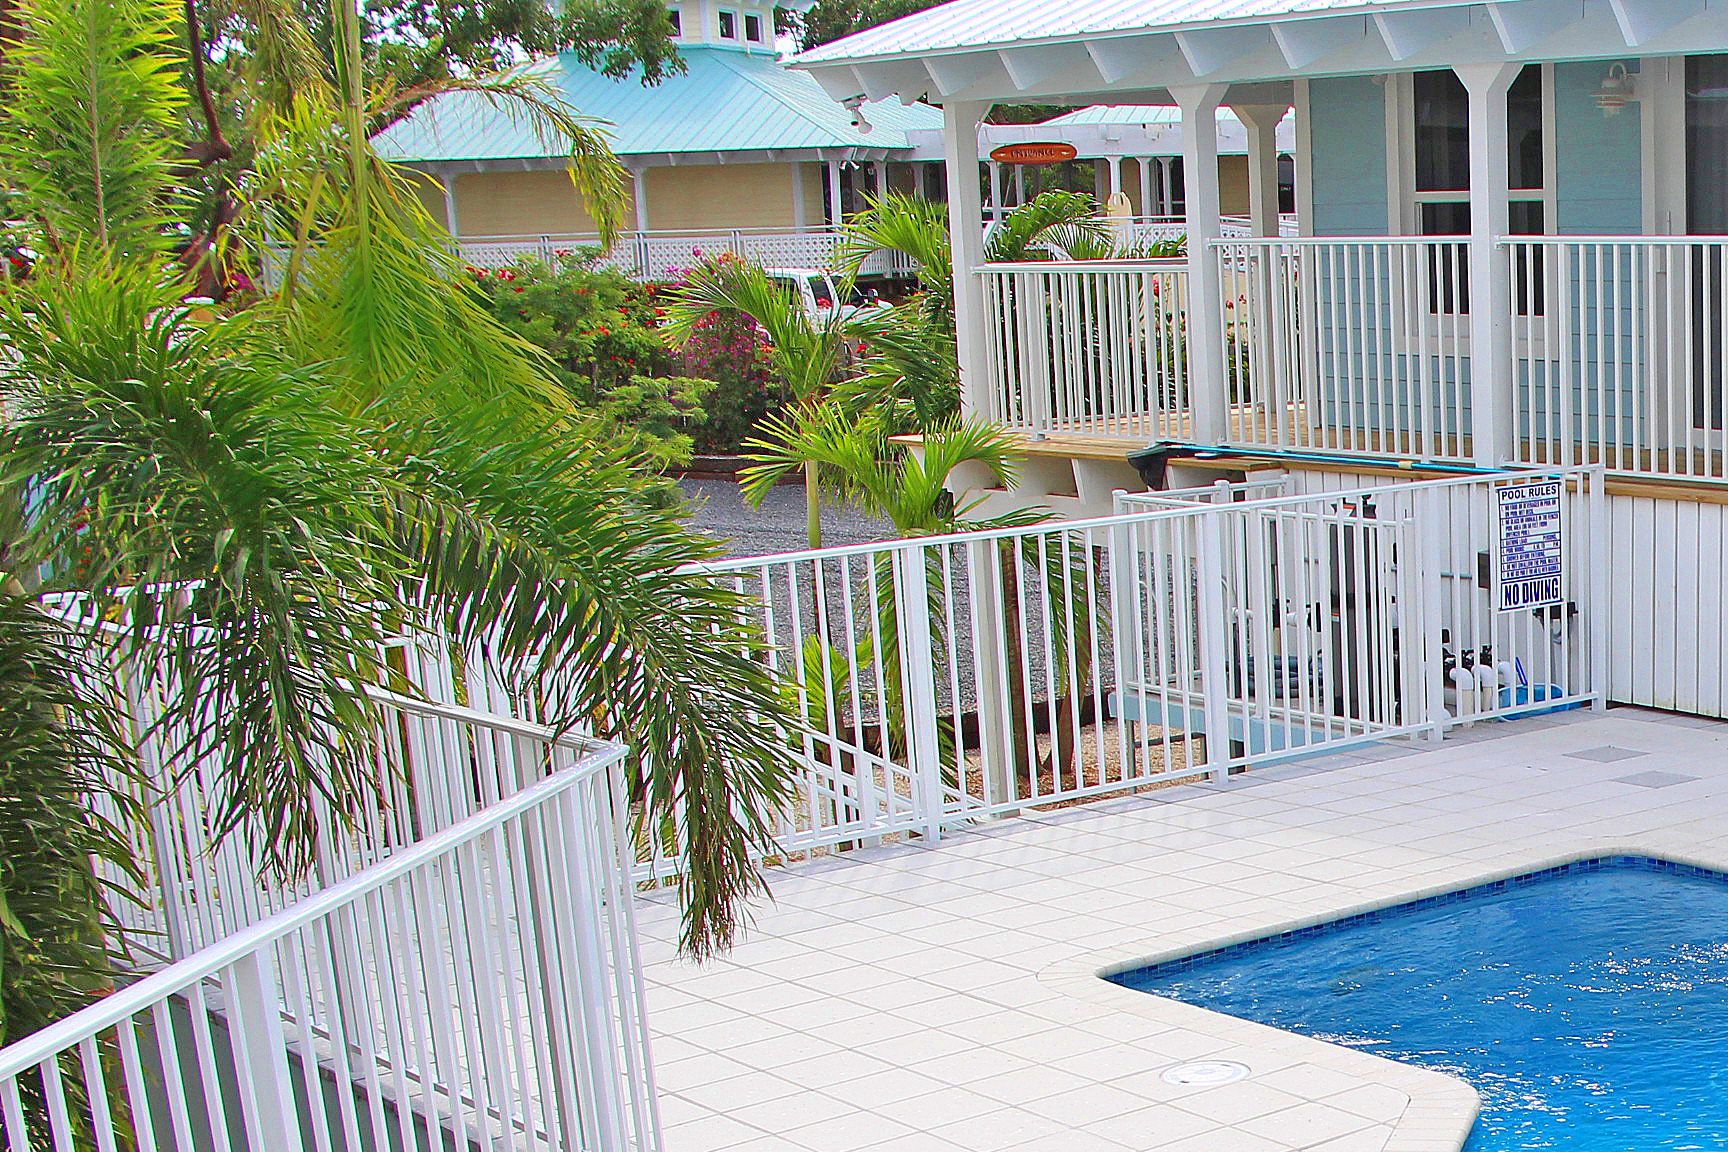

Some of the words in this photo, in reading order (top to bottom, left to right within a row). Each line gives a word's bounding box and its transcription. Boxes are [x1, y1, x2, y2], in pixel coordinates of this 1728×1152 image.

[1501, 489, 1526, 501] POOL
[1528, 485, 1557, 498] RULES
[1504, 583, 1520, 606] NO
[1522, 578, 1559, 603] DIVING
